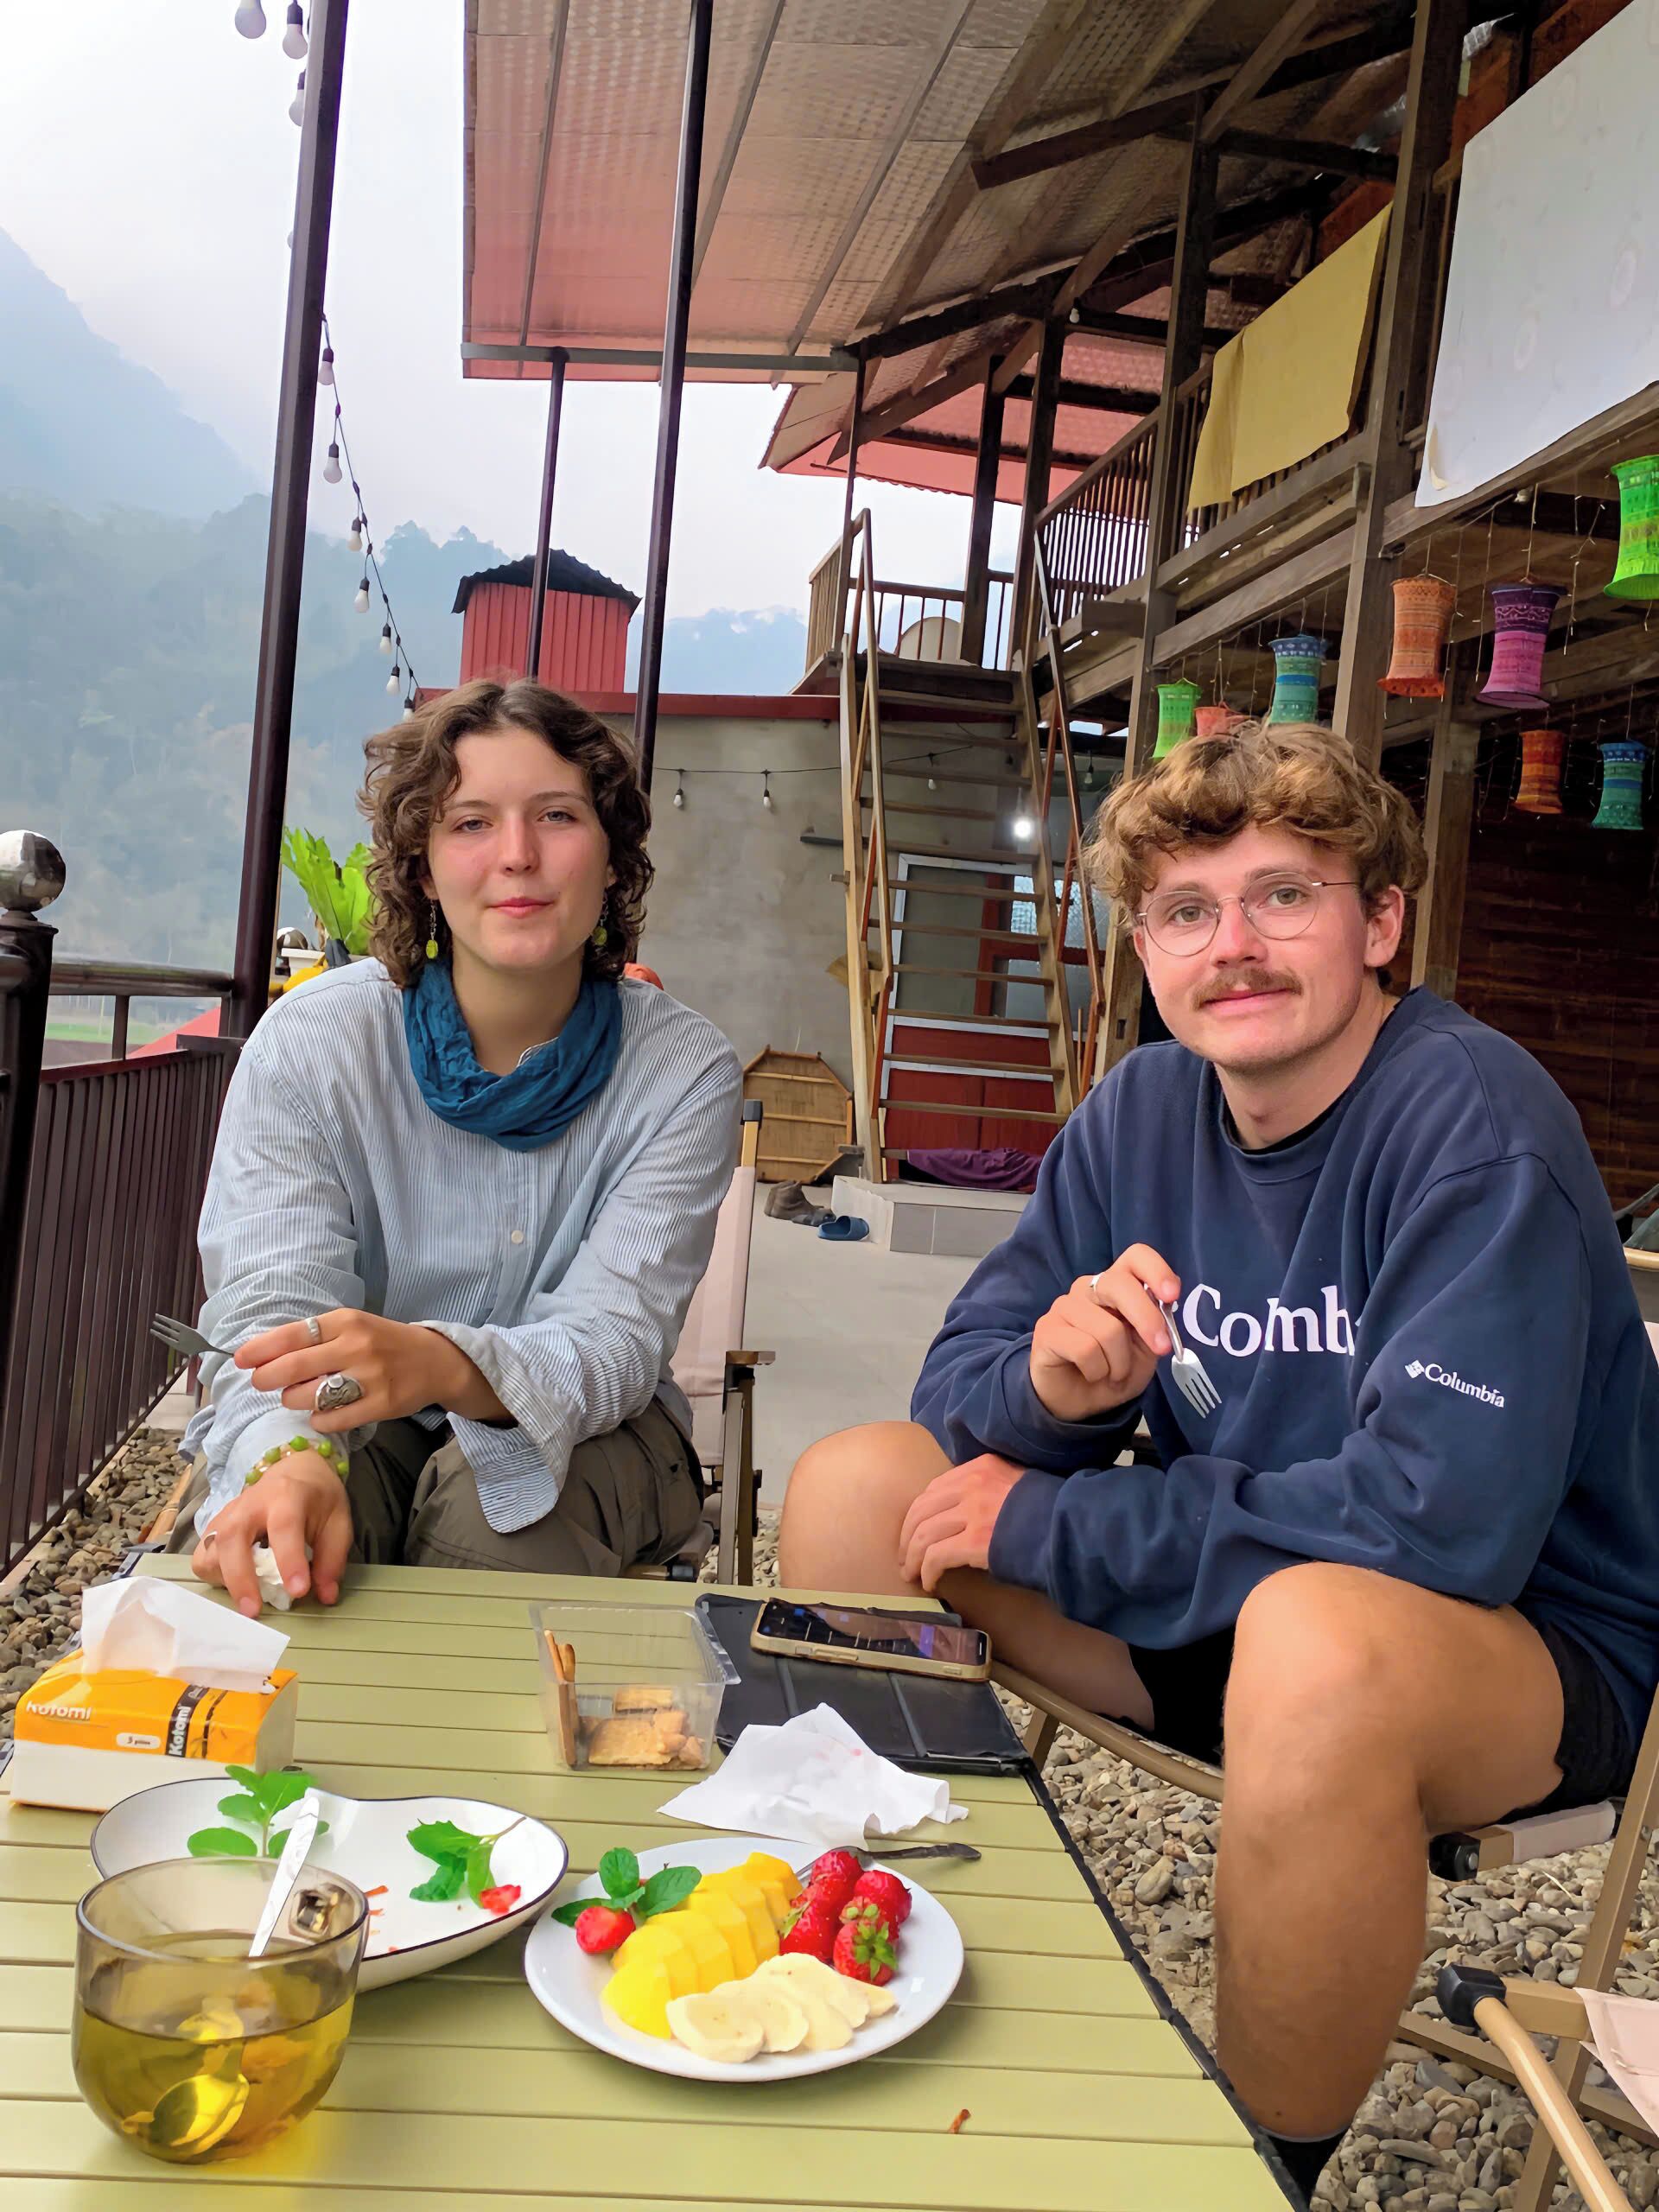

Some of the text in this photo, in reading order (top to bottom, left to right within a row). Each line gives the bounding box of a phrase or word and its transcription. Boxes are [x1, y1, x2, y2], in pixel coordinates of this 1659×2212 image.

[1183, 1283, 1363, 1357] Comb
[1424, 1363, 1505, 1408] Columbia
[168, 1706, 192, 1756] Kotomi
